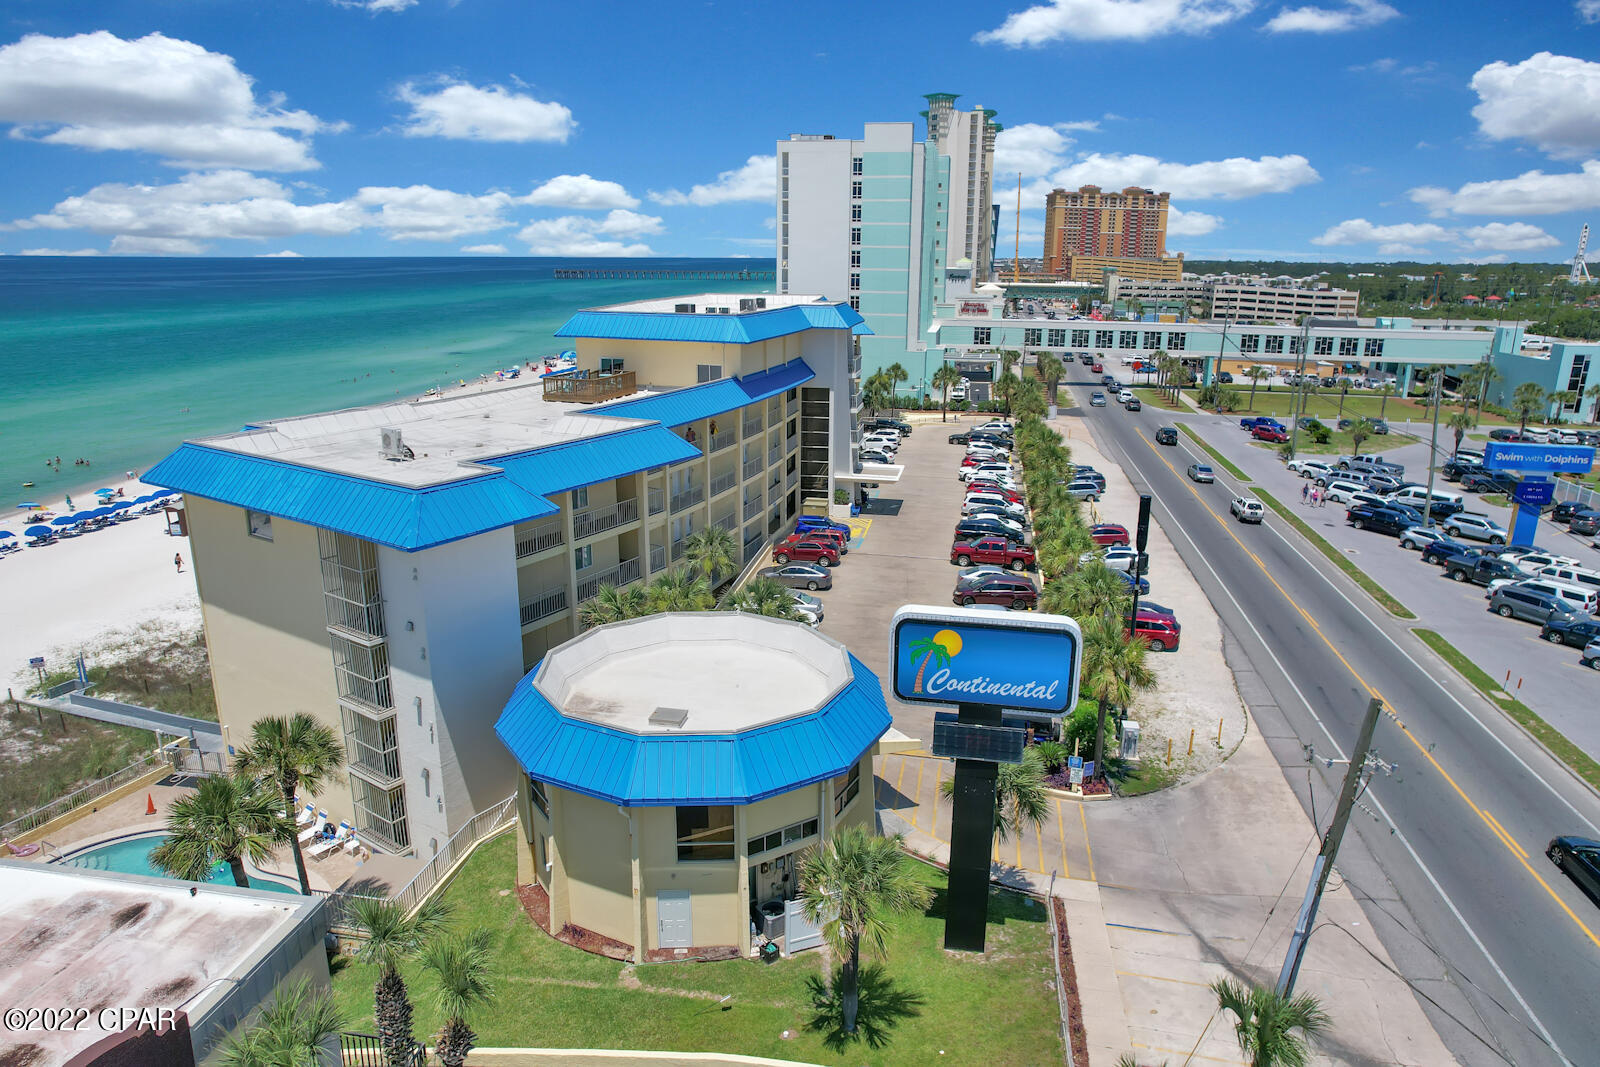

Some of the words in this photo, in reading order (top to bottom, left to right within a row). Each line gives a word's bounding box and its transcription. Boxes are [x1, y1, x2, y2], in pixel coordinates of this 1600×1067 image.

[1496, 452, 1524, 462] Swim
[1544, 454, 1589, 465] Dolphins
[927, 669, 1059, 700] Continental
